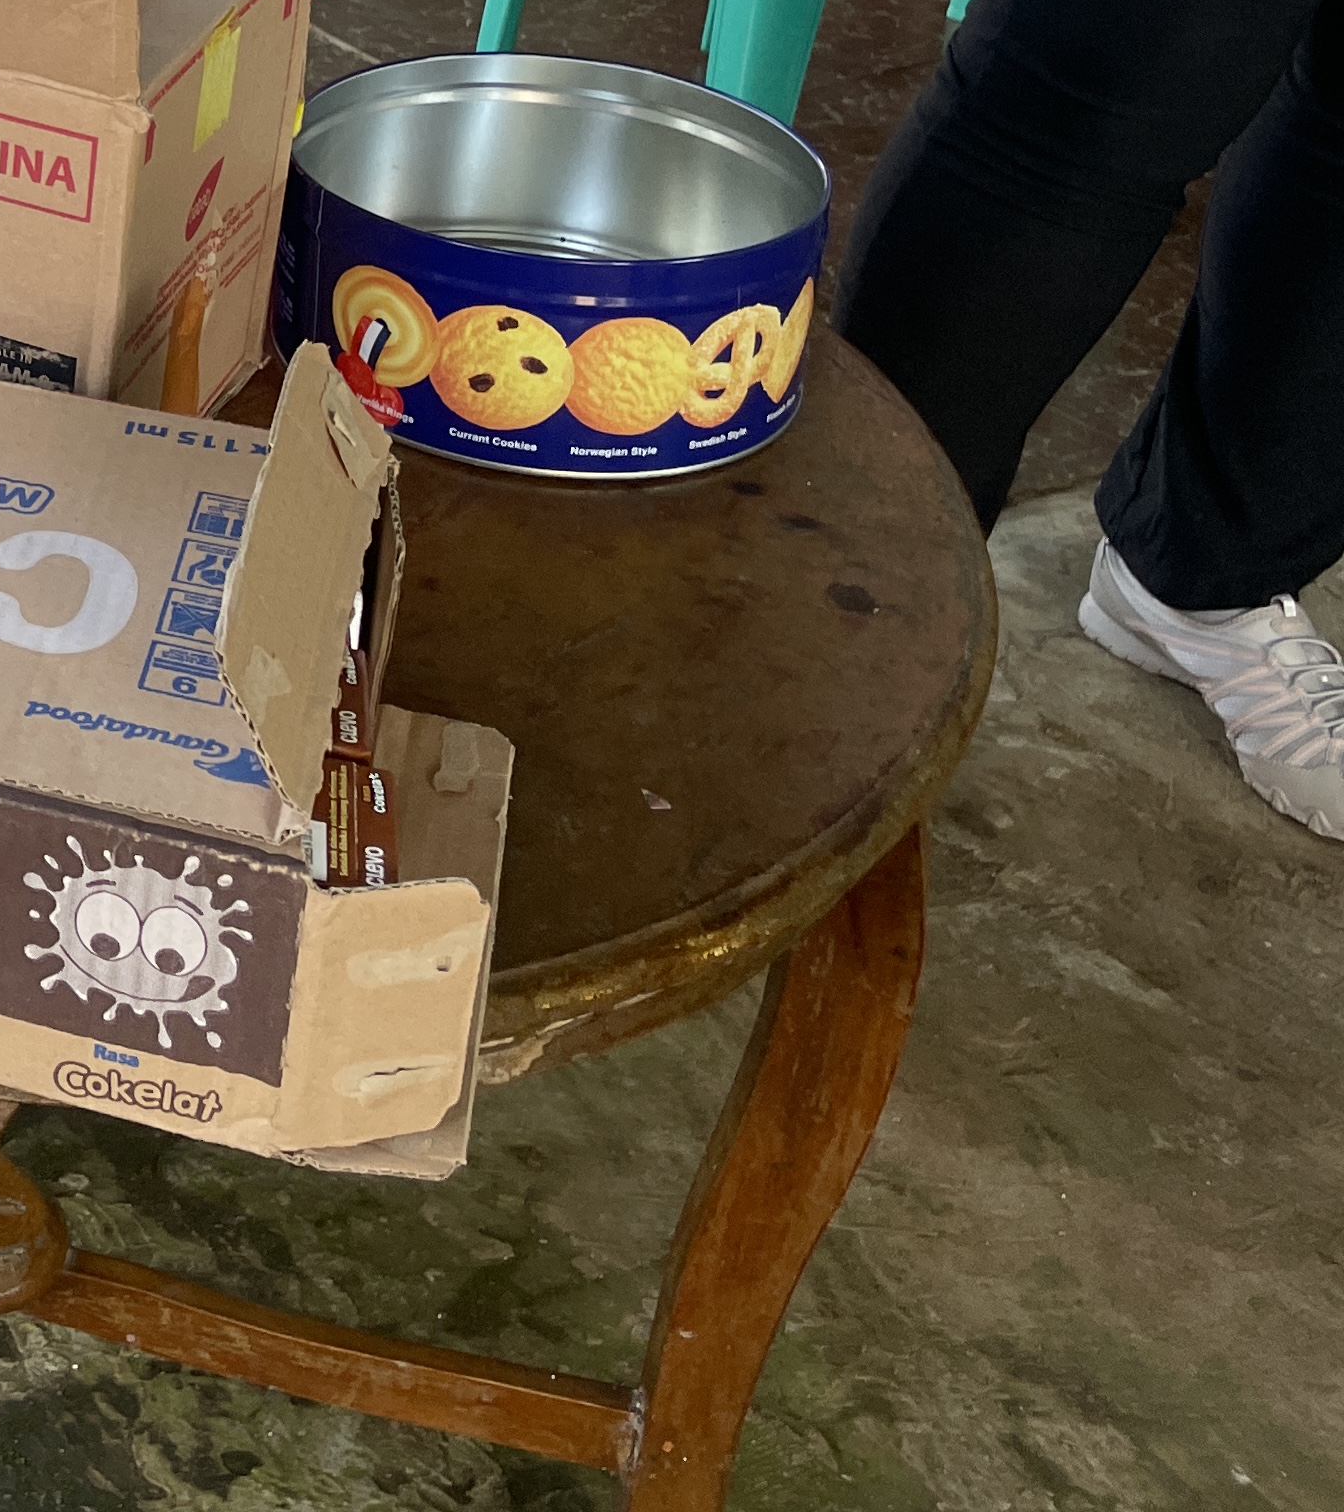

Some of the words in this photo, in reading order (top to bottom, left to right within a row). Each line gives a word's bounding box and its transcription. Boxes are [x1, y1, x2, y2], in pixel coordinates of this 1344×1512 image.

[124, 420, 169, 439] ml
[176, 430, 239, 453] 115
[448, 426, 490, 446] Currant
[491, 435, 538, 452] Cookies
[569, 445, 629, 458] Norwegian
[630, 445, 658, 458] Style
[23, 699, 230, 760] Garudafood
[93, 1043, 140, 1068] Rasa
[52, 1060, 223, 1123] Cokelat
